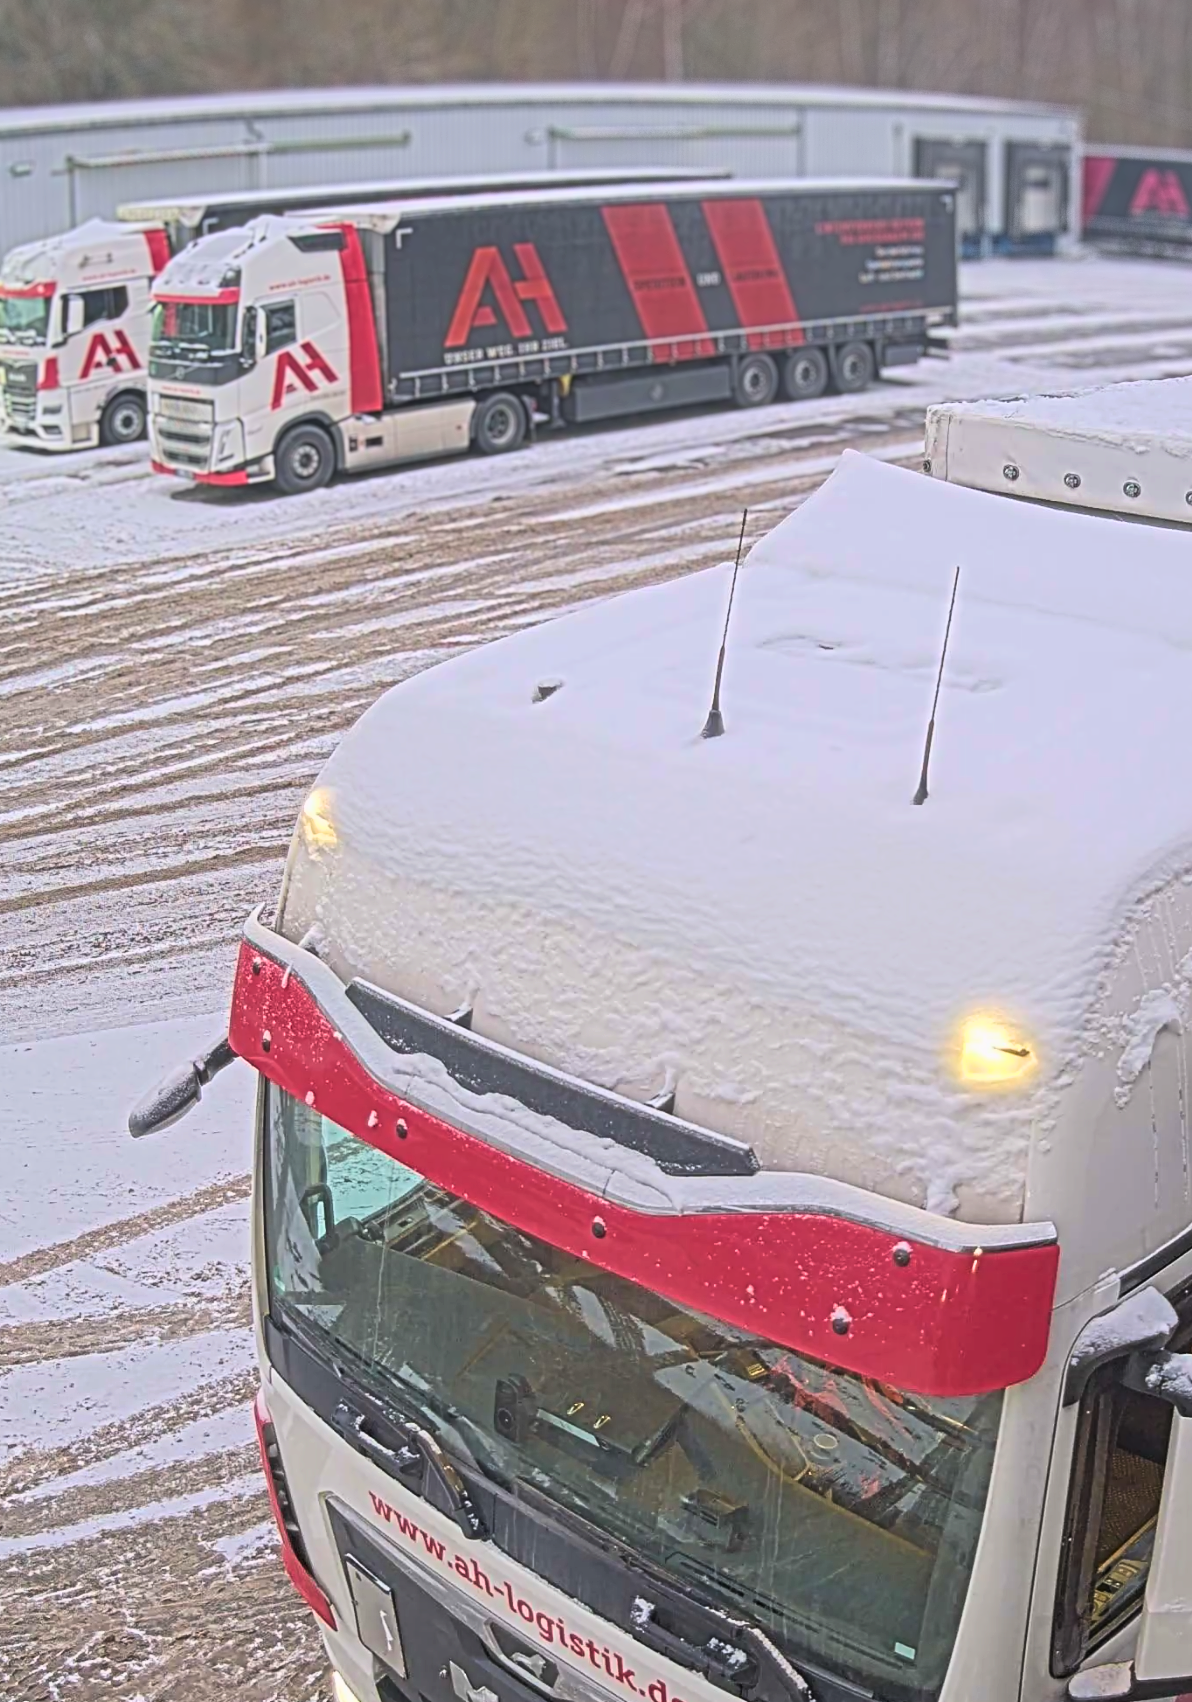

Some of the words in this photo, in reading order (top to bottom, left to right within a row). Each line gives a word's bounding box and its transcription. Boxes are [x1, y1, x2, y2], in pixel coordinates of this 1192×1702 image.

[444, 242, 568, 347] AH
[79, 329, 142, 380] AH
[271, 340, 339, 411] AH
[368, 1490, 685, 1702] www.ah-logistik.d
